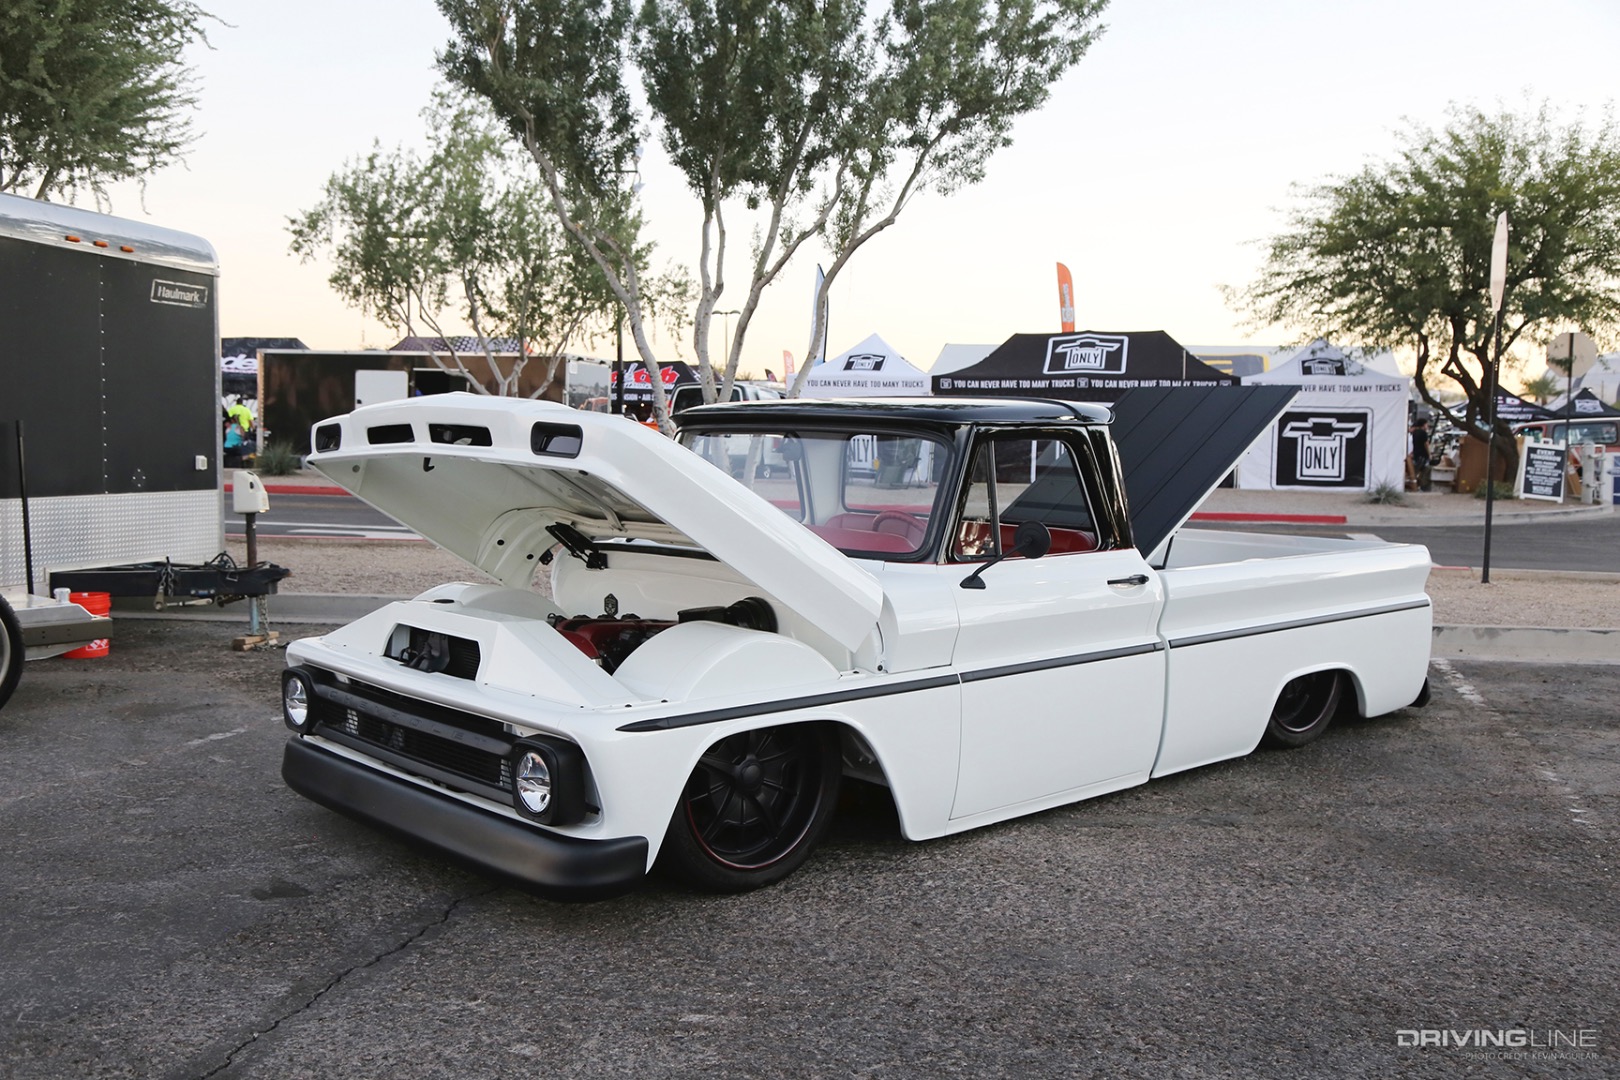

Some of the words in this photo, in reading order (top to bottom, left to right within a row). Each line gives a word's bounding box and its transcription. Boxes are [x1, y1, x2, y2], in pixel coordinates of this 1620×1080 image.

[157, 285, 200, 303] Haulmark
[1072, 353, 1099, 364] ONLY
[853, 380, 868, 388] HAVE
[870, 380, 880, 388] TOO
[882, 380, 899, 388] MANY
[901, 380, 924, 388] TRUCKS
[954, 380, 966, 388] YOU
[967, 380, 980, 388] CAN
[980, 380, 1000, 389] NEVER
[1001, 380, 1017, 388] HAVE
[1019, 380, 1030, 388] TOO
[1031, 380, 1050, 388] MANY
[1051, 379, 1075, 388] TRUCKS
[1091, 380, 1103, 388] YOU
[1104, 380, 1117, 388] CAN
[1119, 380, 1139, 388] NEVER
[1319, 384, 1336, 392] HAVE
[1340, 384, 1352, 392] TOO
[1353, 384, 1373, 392] MANY
[1375, 384, 1402, 392] TRUCKS
[1305, 446, 1338, 470] ONLY
[327, 690, 488, 746] CHEVROLET
